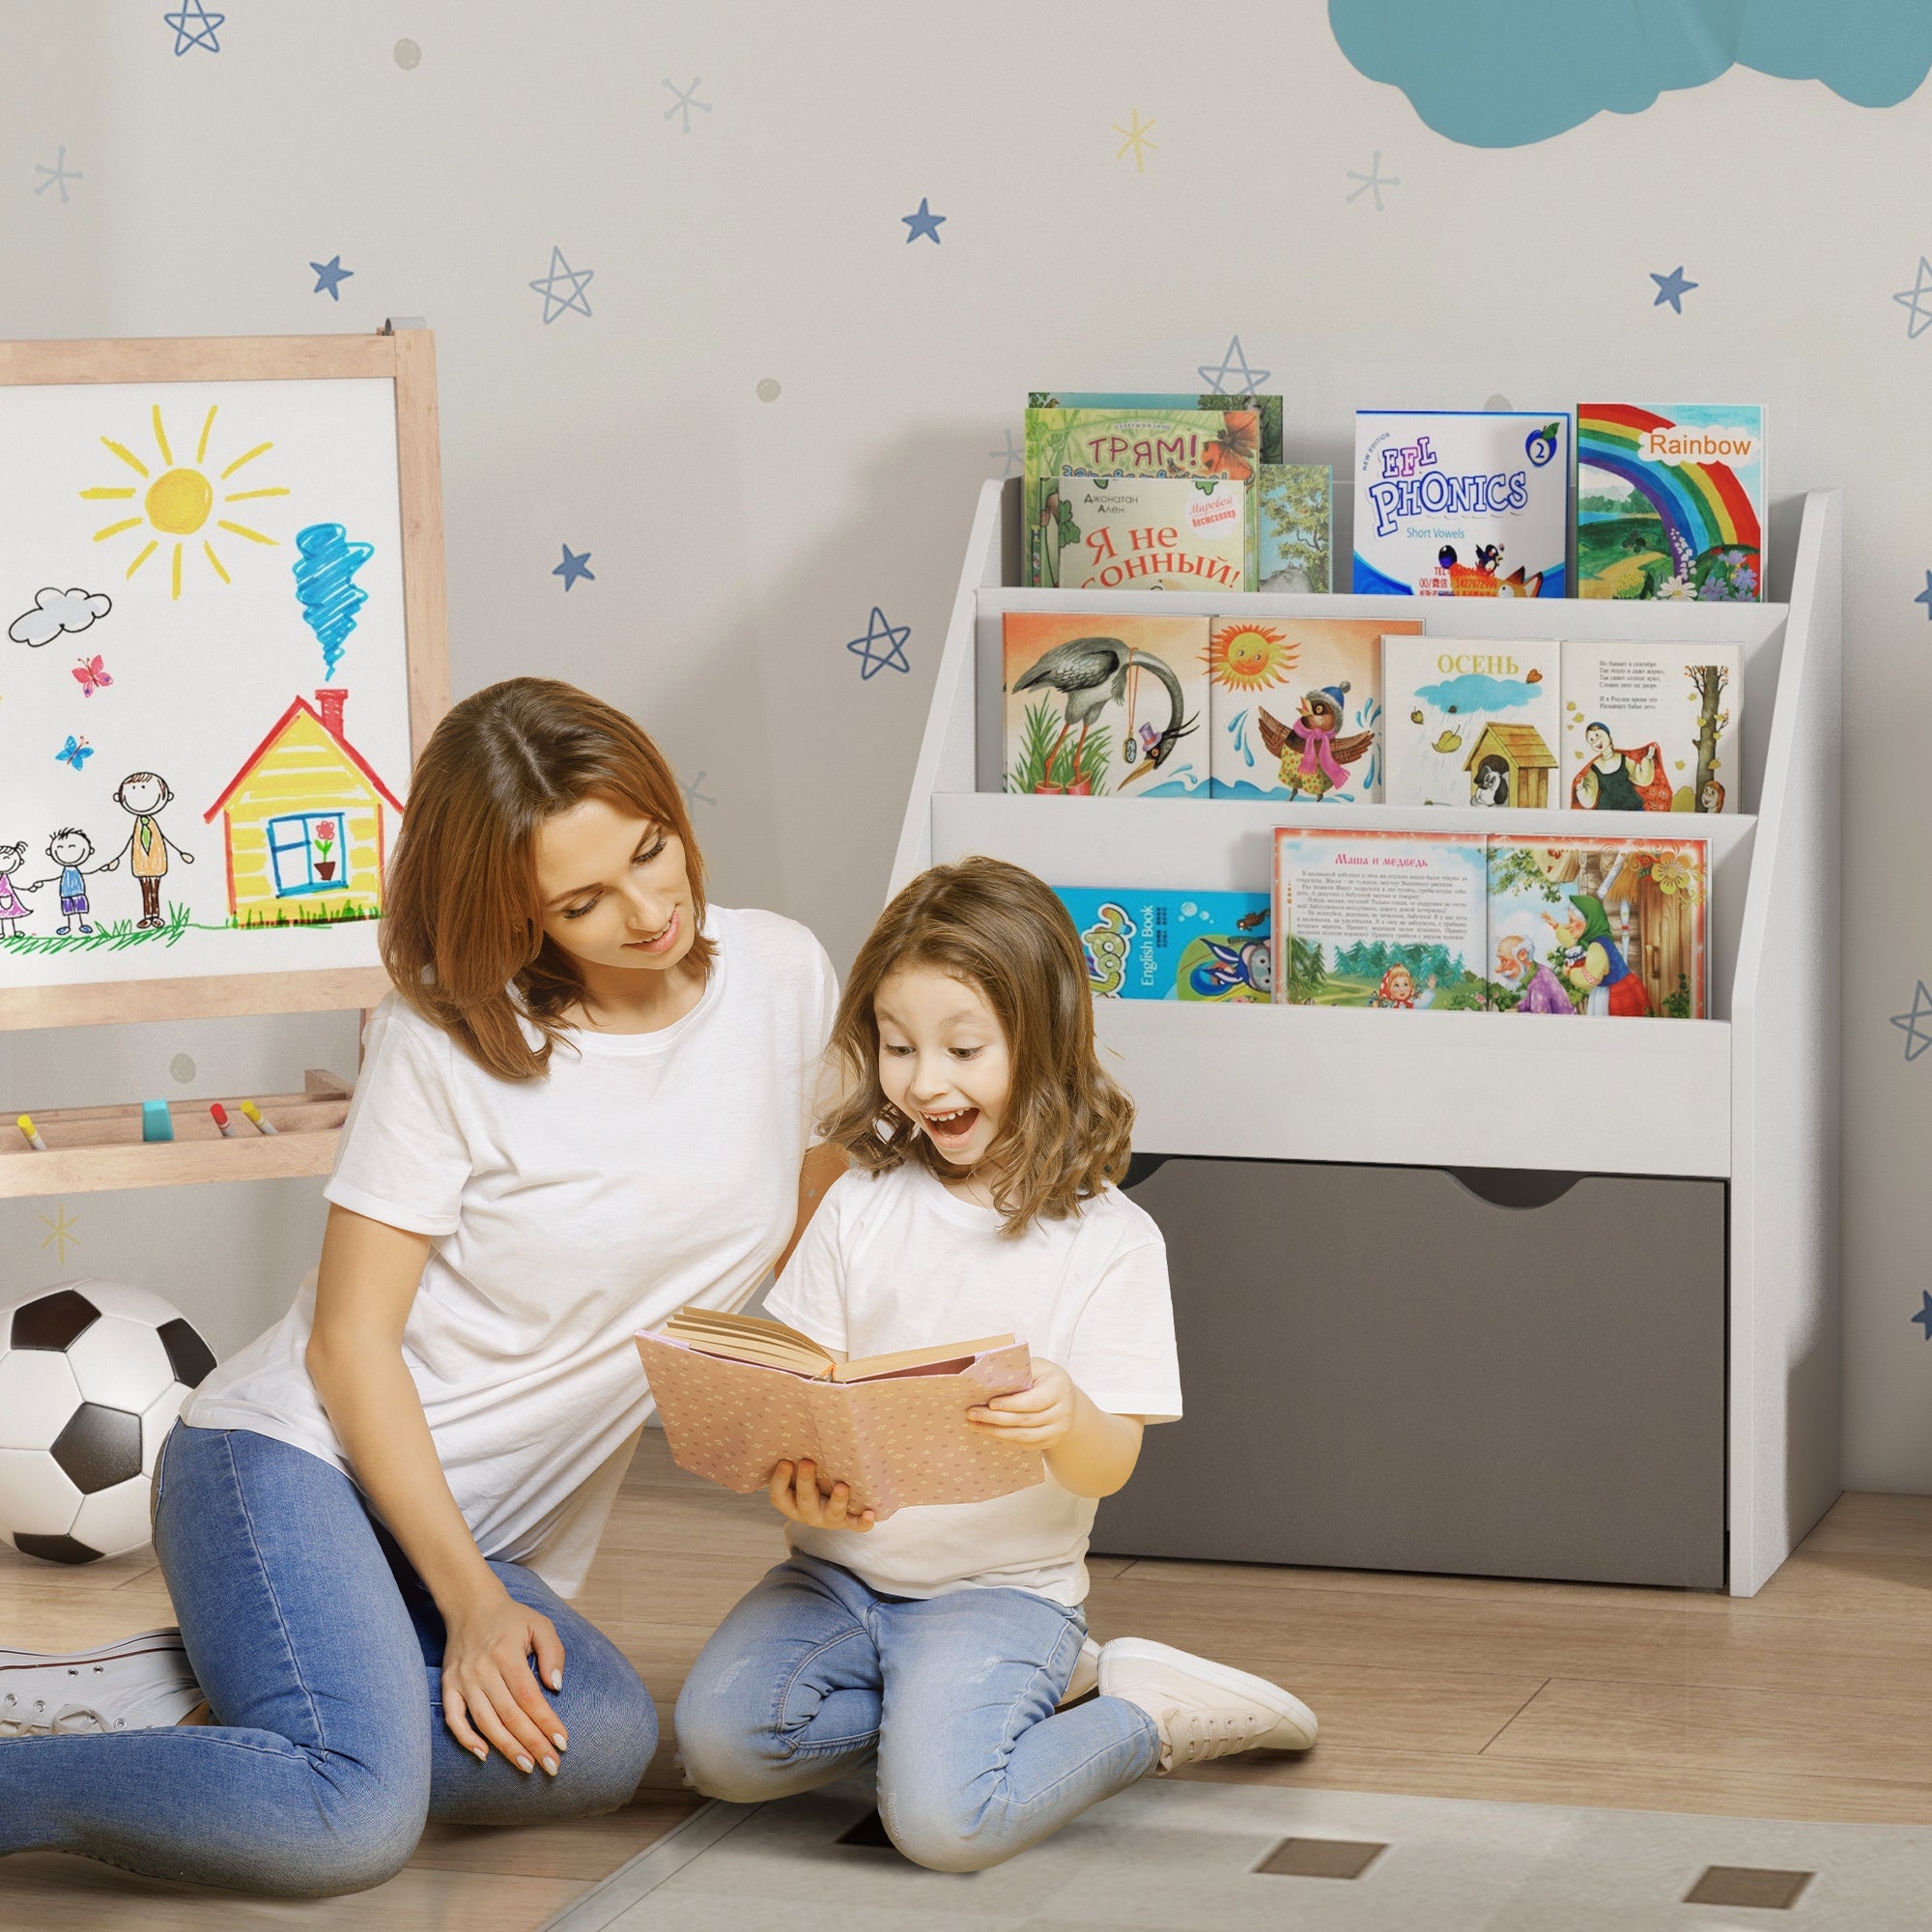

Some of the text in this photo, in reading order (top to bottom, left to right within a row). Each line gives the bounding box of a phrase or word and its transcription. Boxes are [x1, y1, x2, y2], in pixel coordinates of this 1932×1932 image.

[1088, 434, 1198, 467] ТРЯМ!
[1362, 432, 1391, 471] NEW EDITION
[1536, 441, 1546, 459] 2
[1650, 435, 1751, 456] Rainbow
[1382, 436, 1437, 478] EFL
[1084, 494, 1139, 504] Джонатан
[1097, 504, 1125, 514] Ален
[1188, 496, 1234, 516] Мировой
[1369, 470, 1528, 537] PHONICS
[1406, 526, 1465, 539] Short Vowels
[1086, 526, 1179, 567] Я не
[1436, 654, 1520, 674] ОСЕНЬ
[1335, 853, 1429, 867] Маша и медведь
[1140, 904, 1157, 986] English Book
